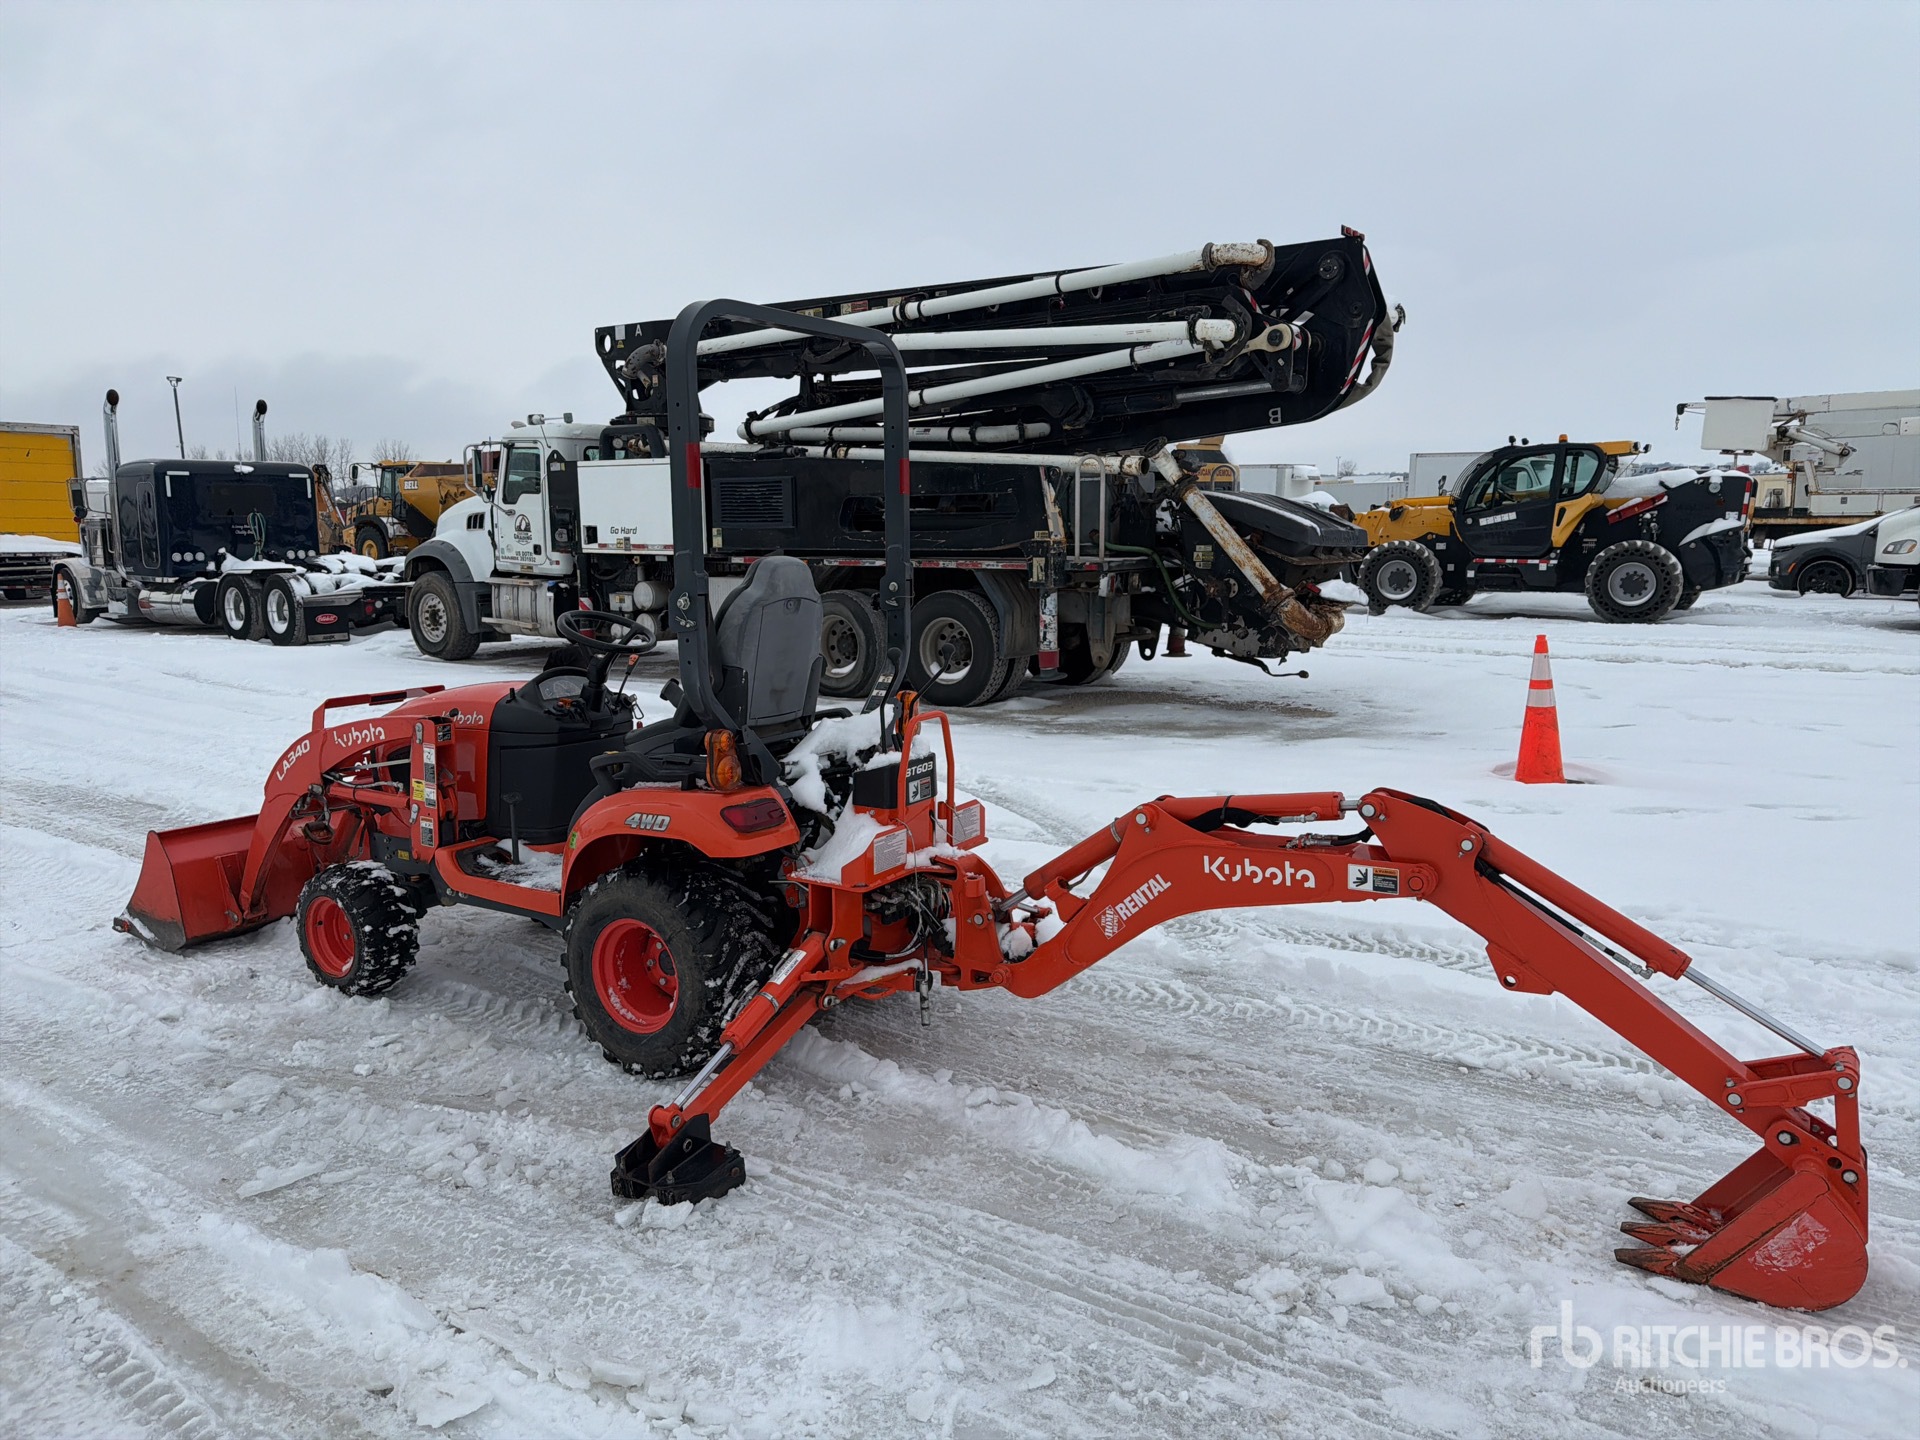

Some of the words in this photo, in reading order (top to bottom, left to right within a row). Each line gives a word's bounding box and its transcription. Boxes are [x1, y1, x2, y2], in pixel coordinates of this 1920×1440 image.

[635, 324, 643, 337] A
[1268, 407, 1282, 425] B
[404, 480, 418, 490] BELL
[610, 526, 619, 535] Go
[620, 526, 638, 535] Hard
[333, 723, 385, 748] Kubota
[276, 739, 311, 782] LA340
[624, 812, 671, 832] 4WD
[1203, 855, 1316, 889] Kubota
[1114, 873, 1172, 921] RENTAL
[1104, 907, 1114, 938] HOME
